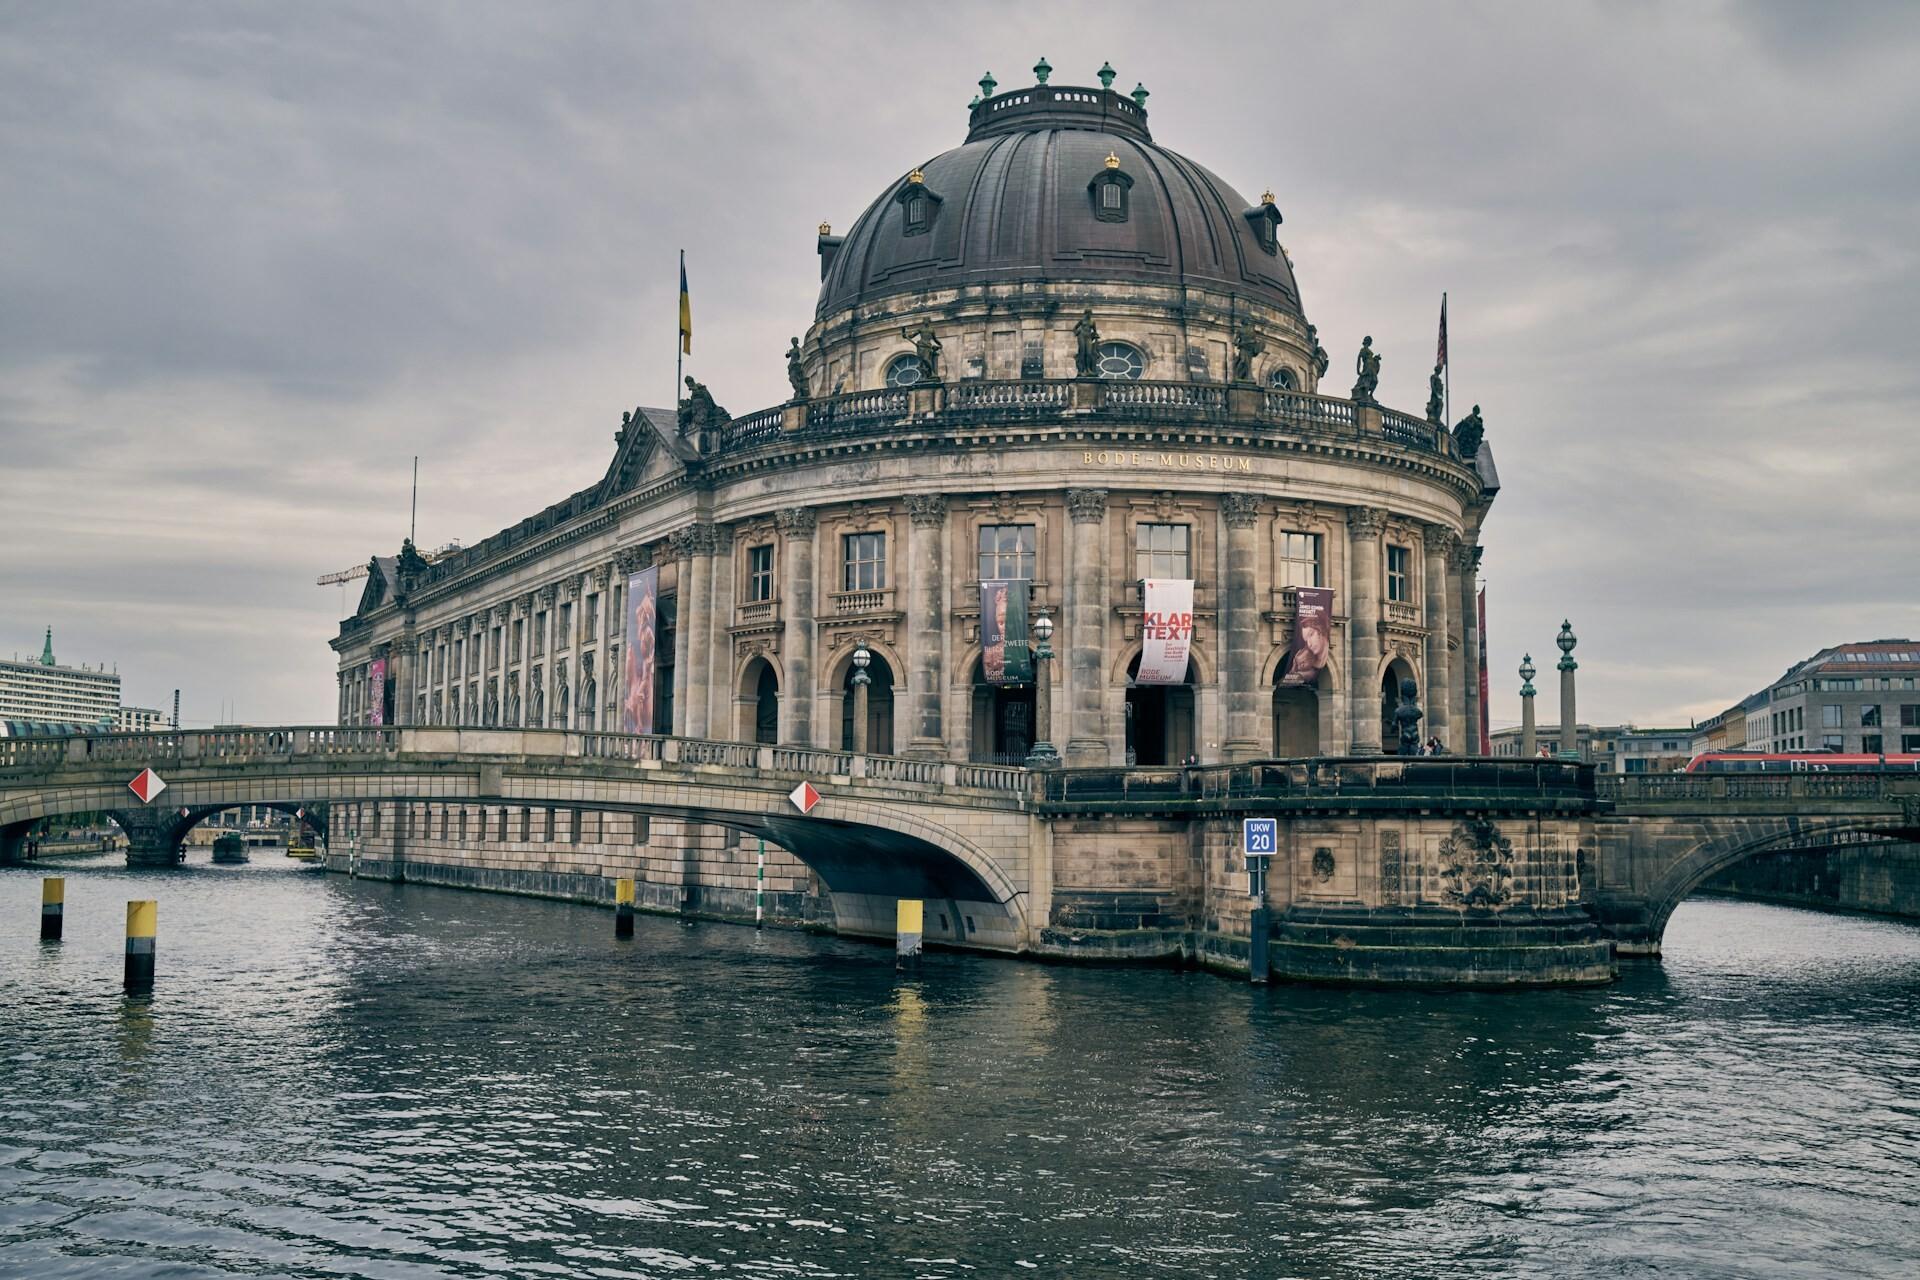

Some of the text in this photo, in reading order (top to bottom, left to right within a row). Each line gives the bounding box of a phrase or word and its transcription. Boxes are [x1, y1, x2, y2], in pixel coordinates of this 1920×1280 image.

[1083, 452, 1250, 470] BODE-MUSEUM
[1143, 612, 1191, 626] KLAR
[1143, 626, 1191, 640] TEXT
[1004, 639, 1029, 647] ZWEITE
[1760, 761, 1766, 770] 1
[1250, 823, 1270, 832] UKW
[1251, 834, 1270, 850] 20
